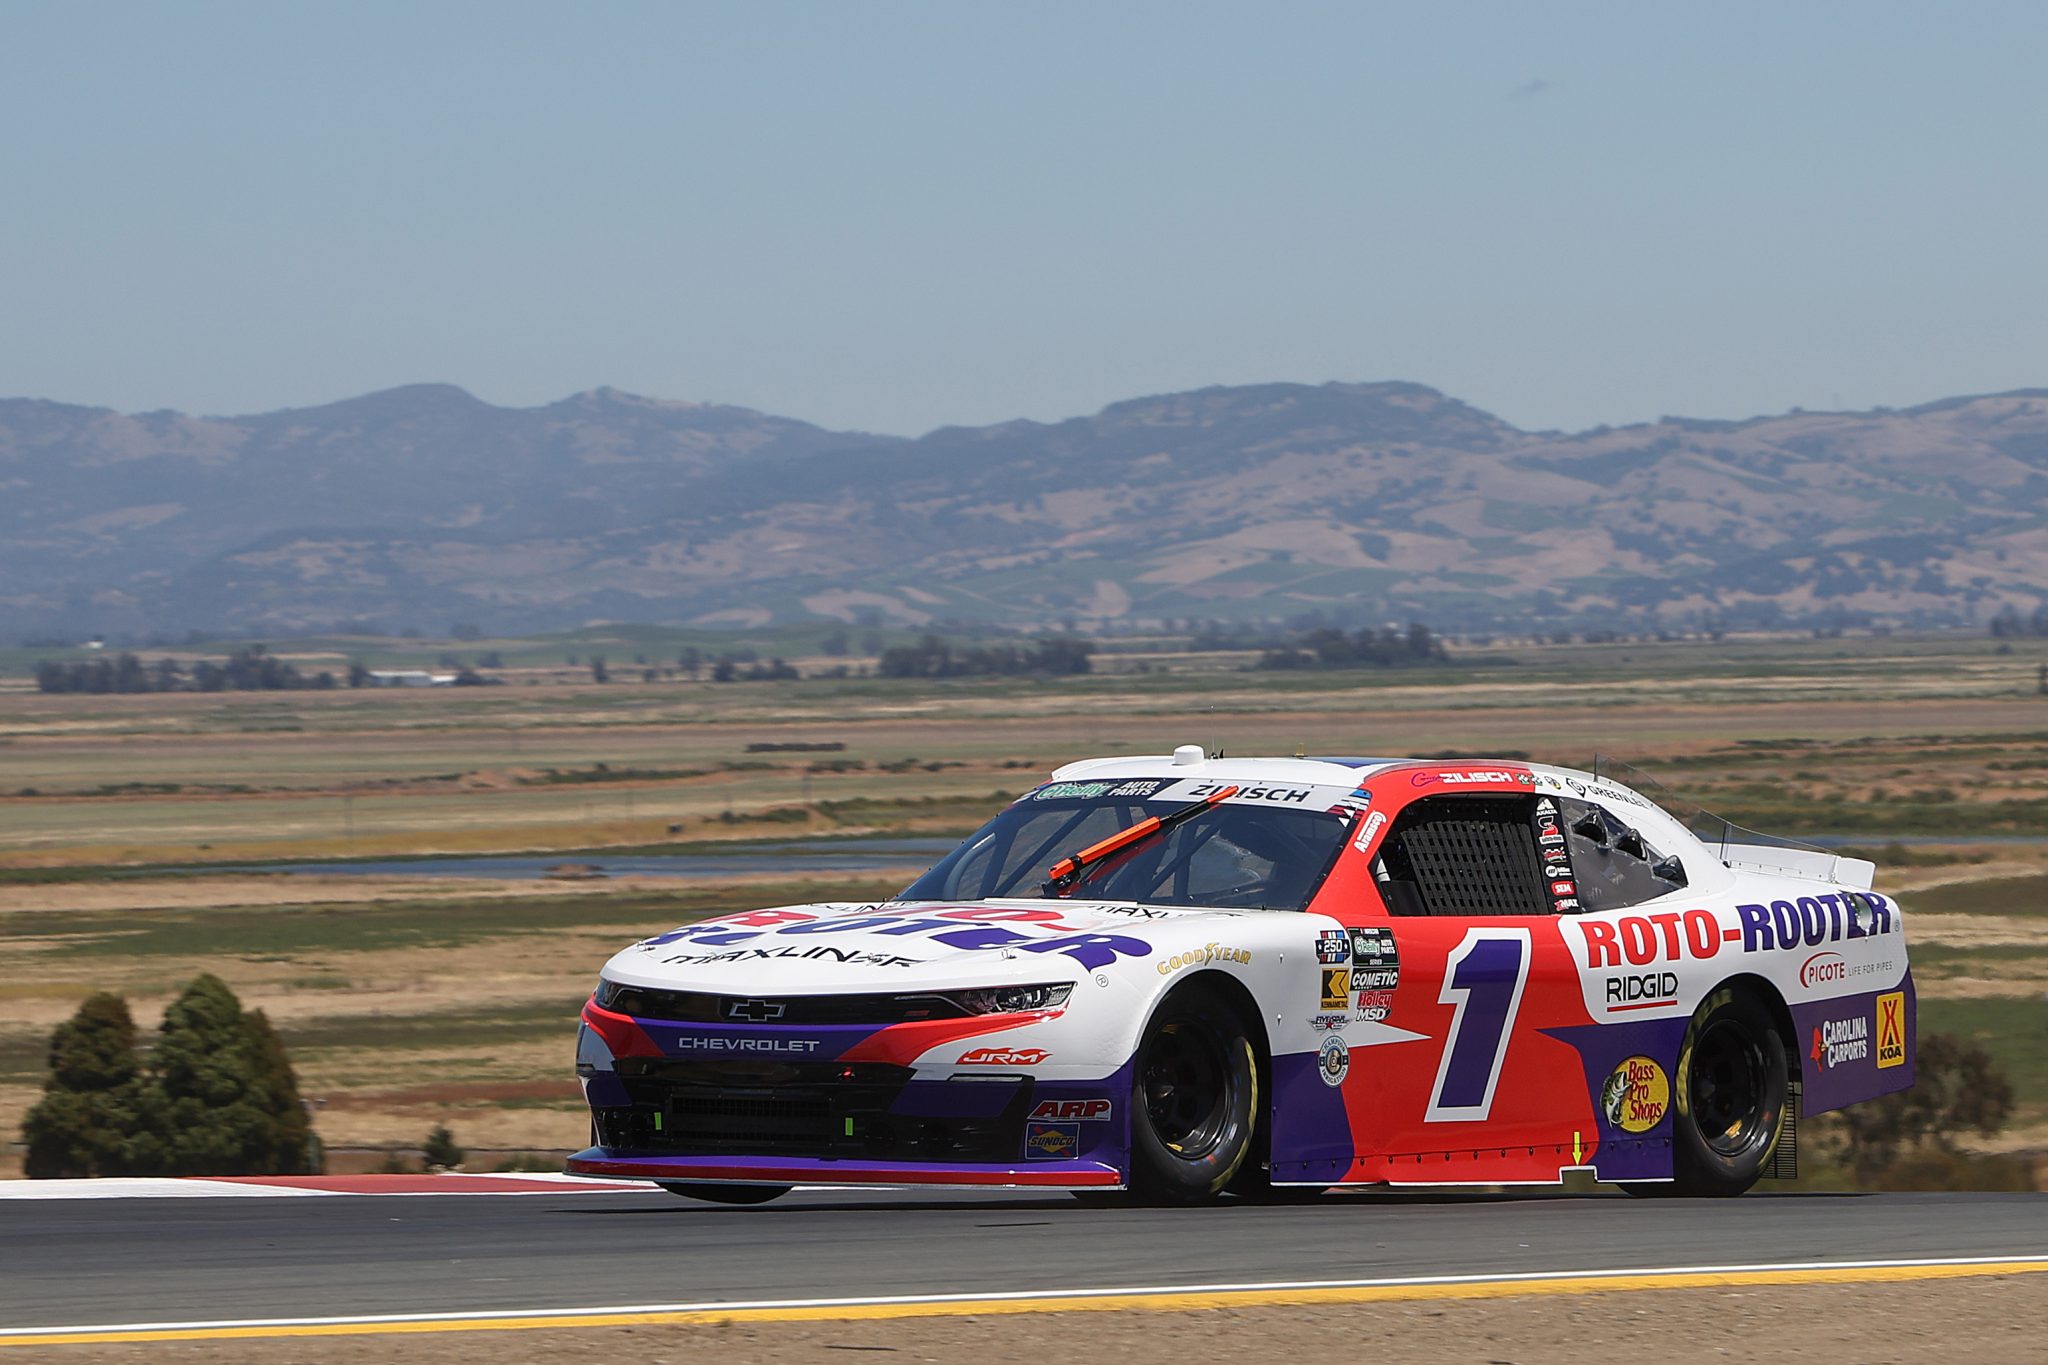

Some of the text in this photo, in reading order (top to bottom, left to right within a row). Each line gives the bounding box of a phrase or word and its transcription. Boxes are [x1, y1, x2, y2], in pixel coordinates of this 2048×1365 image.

[1120, 781, 1160, 790] AUTO
[1439, 772, 1514, 784] ZILISCH
[1108, 788, 1154, 797] PARTS
[1188, 784, 1311, 803] ZIISCH
[1353, 814, 1384, 854] Aramsco
[1555, 884, 1572, 893] SEM
[1323, 940, 1343, 953] 250
[1352, 971, 1398, 986] COMETIC
[1809, 961, 1893, 982] PICOTE LIFE FOR PIPES
[1607, 972, 1678, 1003] RIDGID
[1357, 1008, 1386, 1021] MSD
[1424, 927, 1532, 1122] 1
[1823, 1017, 1867, 1048] CAROLINA
[679, 1036, 820, 1052] CHEVROLET
[963, 1052, 1039, 1065] JRM
[1828, 1040, 1867, 1068] CARPORTS
[1880, 1046, 1902, 1060] KOA
[1629, 1061, 1655, 1081] Bass
[1629, 1081, 1649, 1100] Pro
[1032, 1101, 1110, 1117] ARP
[1629, 1099, 1662, 1124] Shops
[1030, 1135, 1075, 1147] SUNOCO
